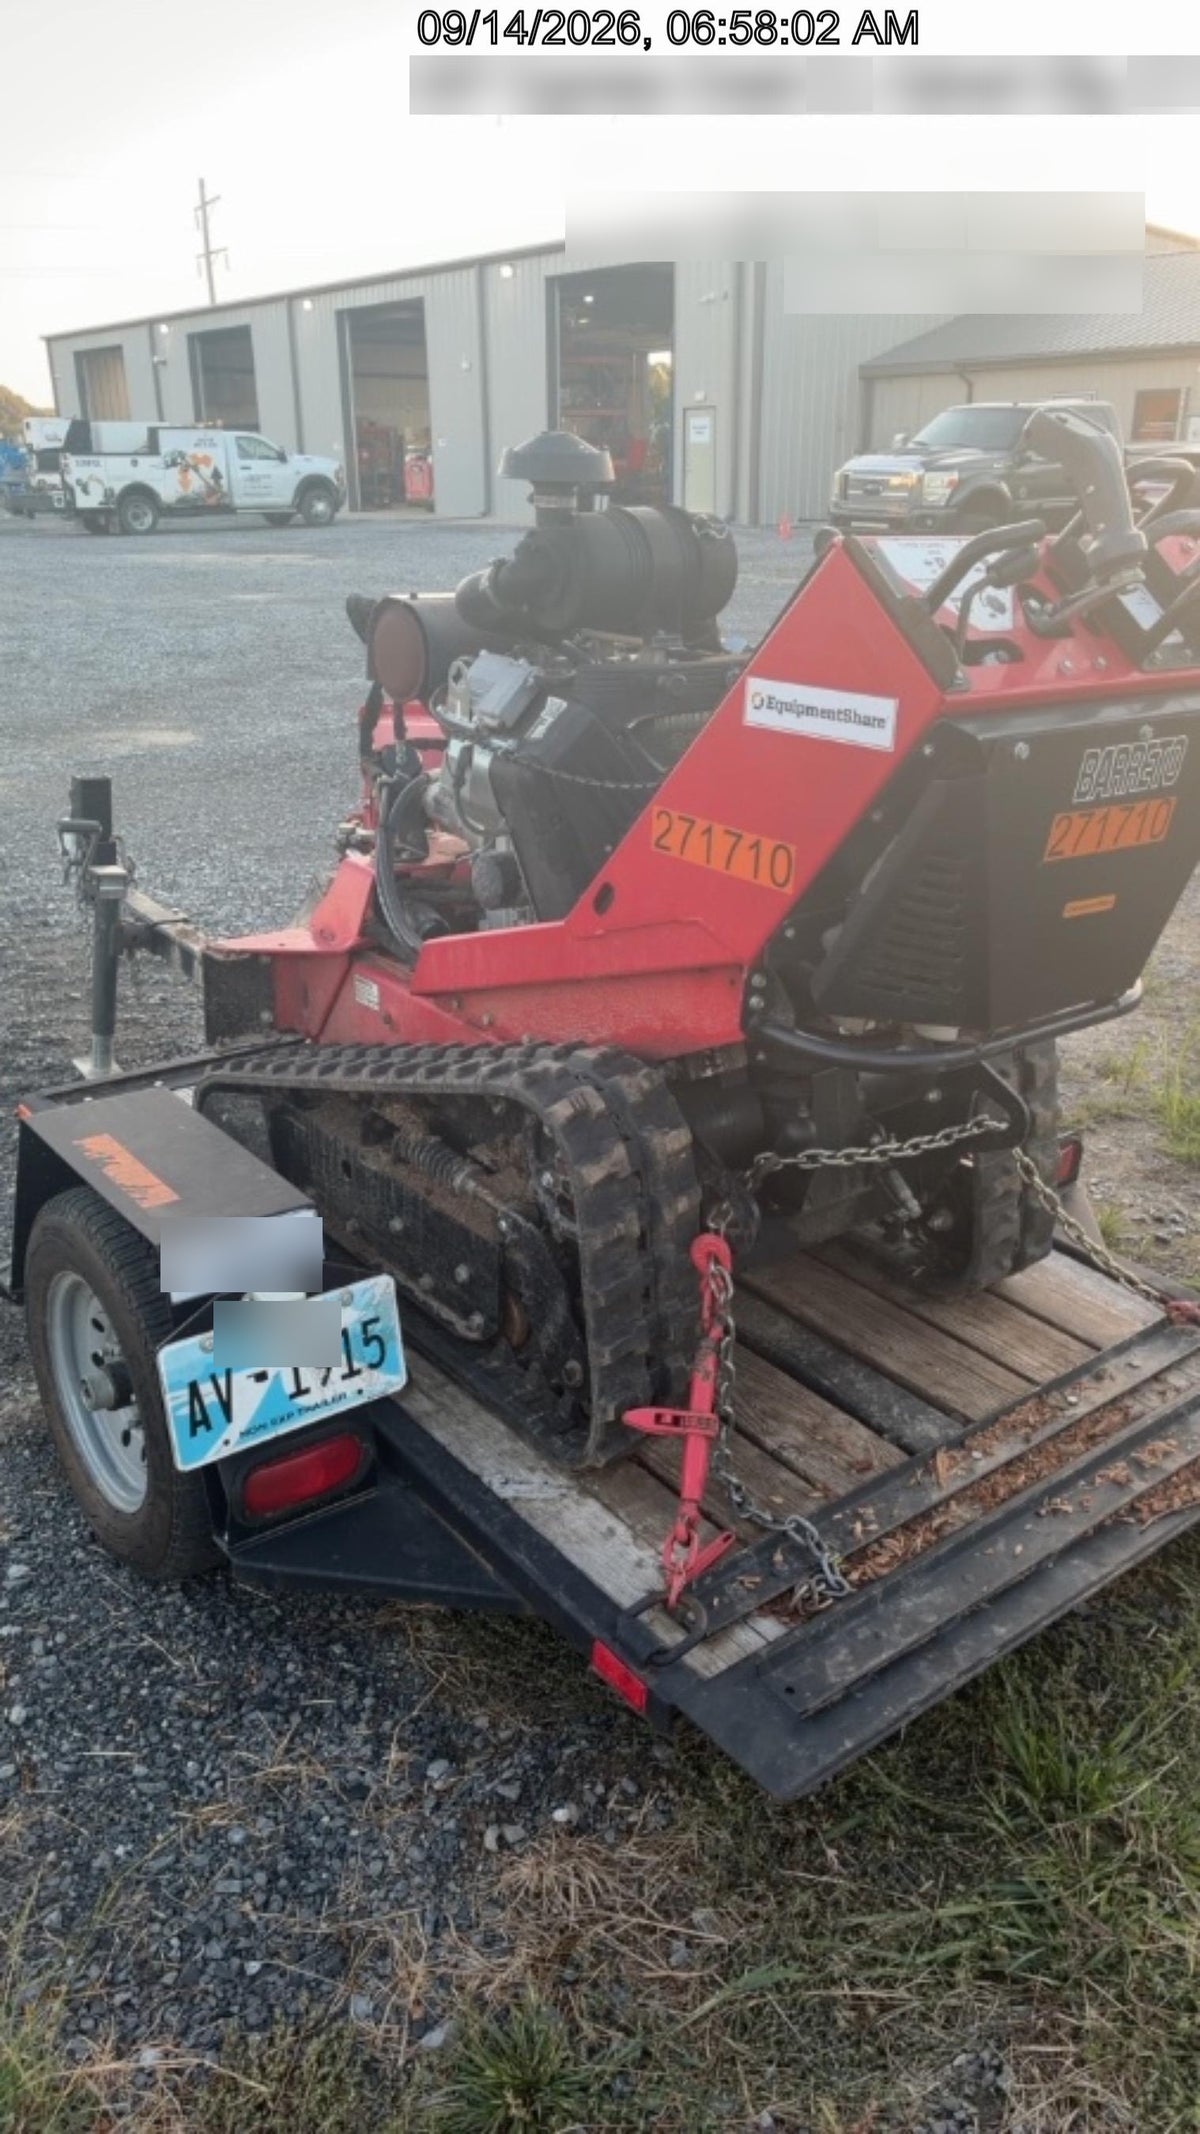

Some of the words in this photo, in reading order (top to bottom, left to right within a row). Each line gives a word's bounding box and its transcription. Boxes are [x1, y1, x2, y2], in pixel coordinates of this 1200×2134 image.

[765, 695, 887, 729] EquipmentShare
[1072, 735, 1188, 803] BARRETO
[655, 810, 794, 888] 271710
[1048, 798, 1172, 856] 271710
